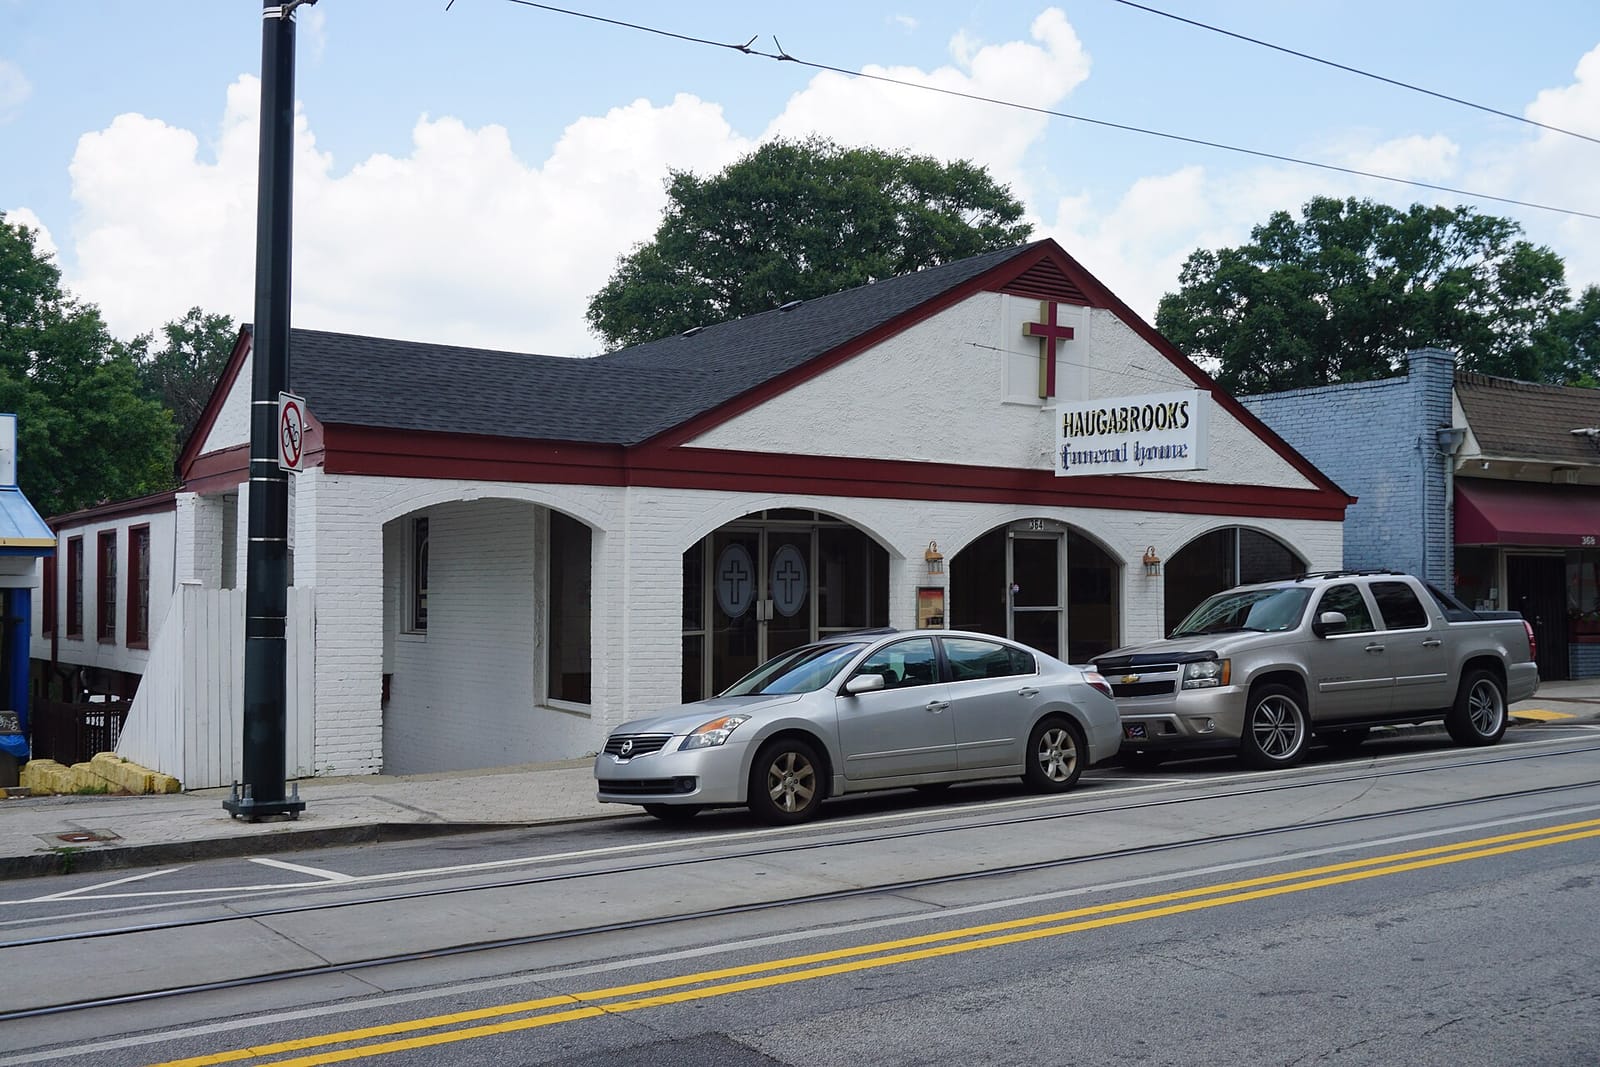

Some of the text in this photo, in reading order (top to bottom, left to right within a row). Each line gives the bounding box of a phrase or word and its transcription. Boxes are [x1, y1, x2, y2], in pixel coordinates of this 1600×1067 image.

[1063, 401, 1189, 438] HAUGABROOKS
[1060, 441, 1188, 470] funeral home
[1030, 519, 1043, 530] 364
